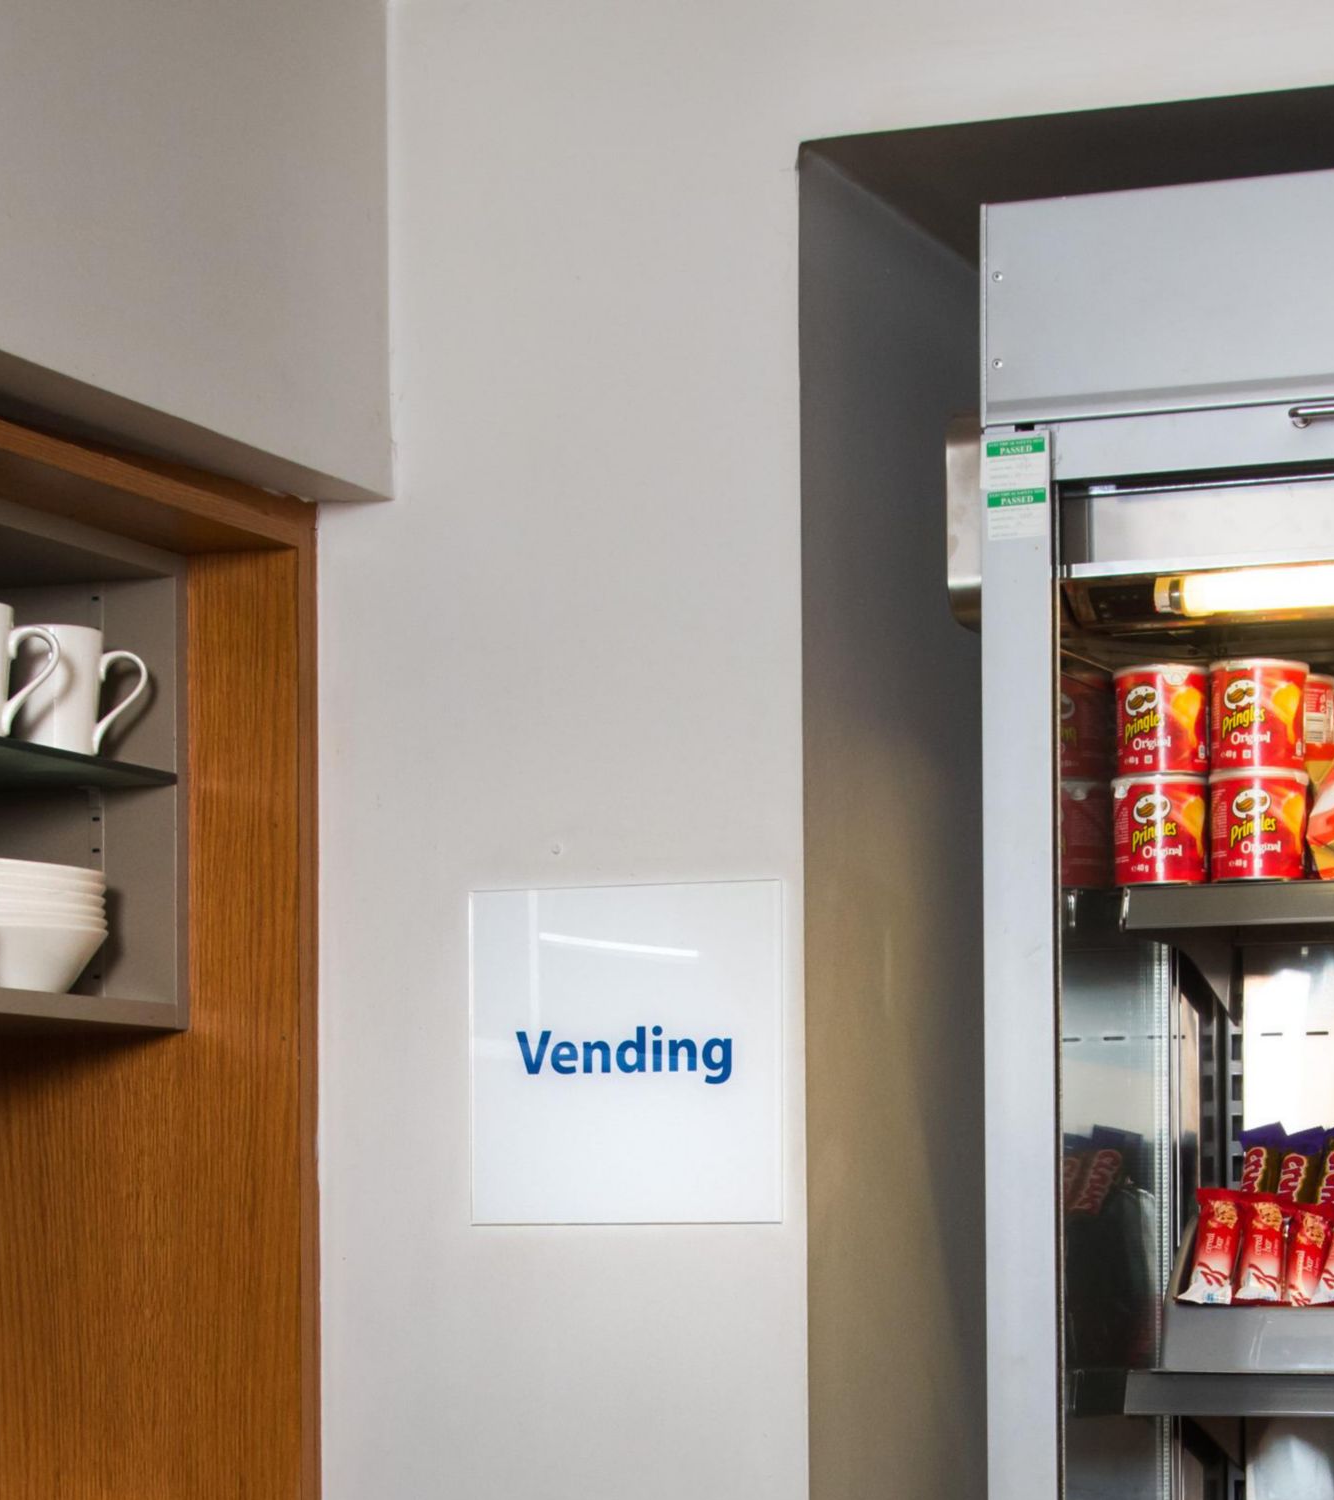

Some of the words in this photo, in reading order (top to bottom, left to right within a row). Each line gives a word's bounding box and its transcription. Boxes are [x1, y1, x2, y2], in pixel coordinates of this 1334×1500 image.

[1000, 445, 1033, 455] PASSED
[1001, 495, 1033, 505] PASSED
[1132, 820, 1177, 853] Prinles
[1230, 815, 1276, 848] Prinles
[516, 1025, 733, 1085] Vending
